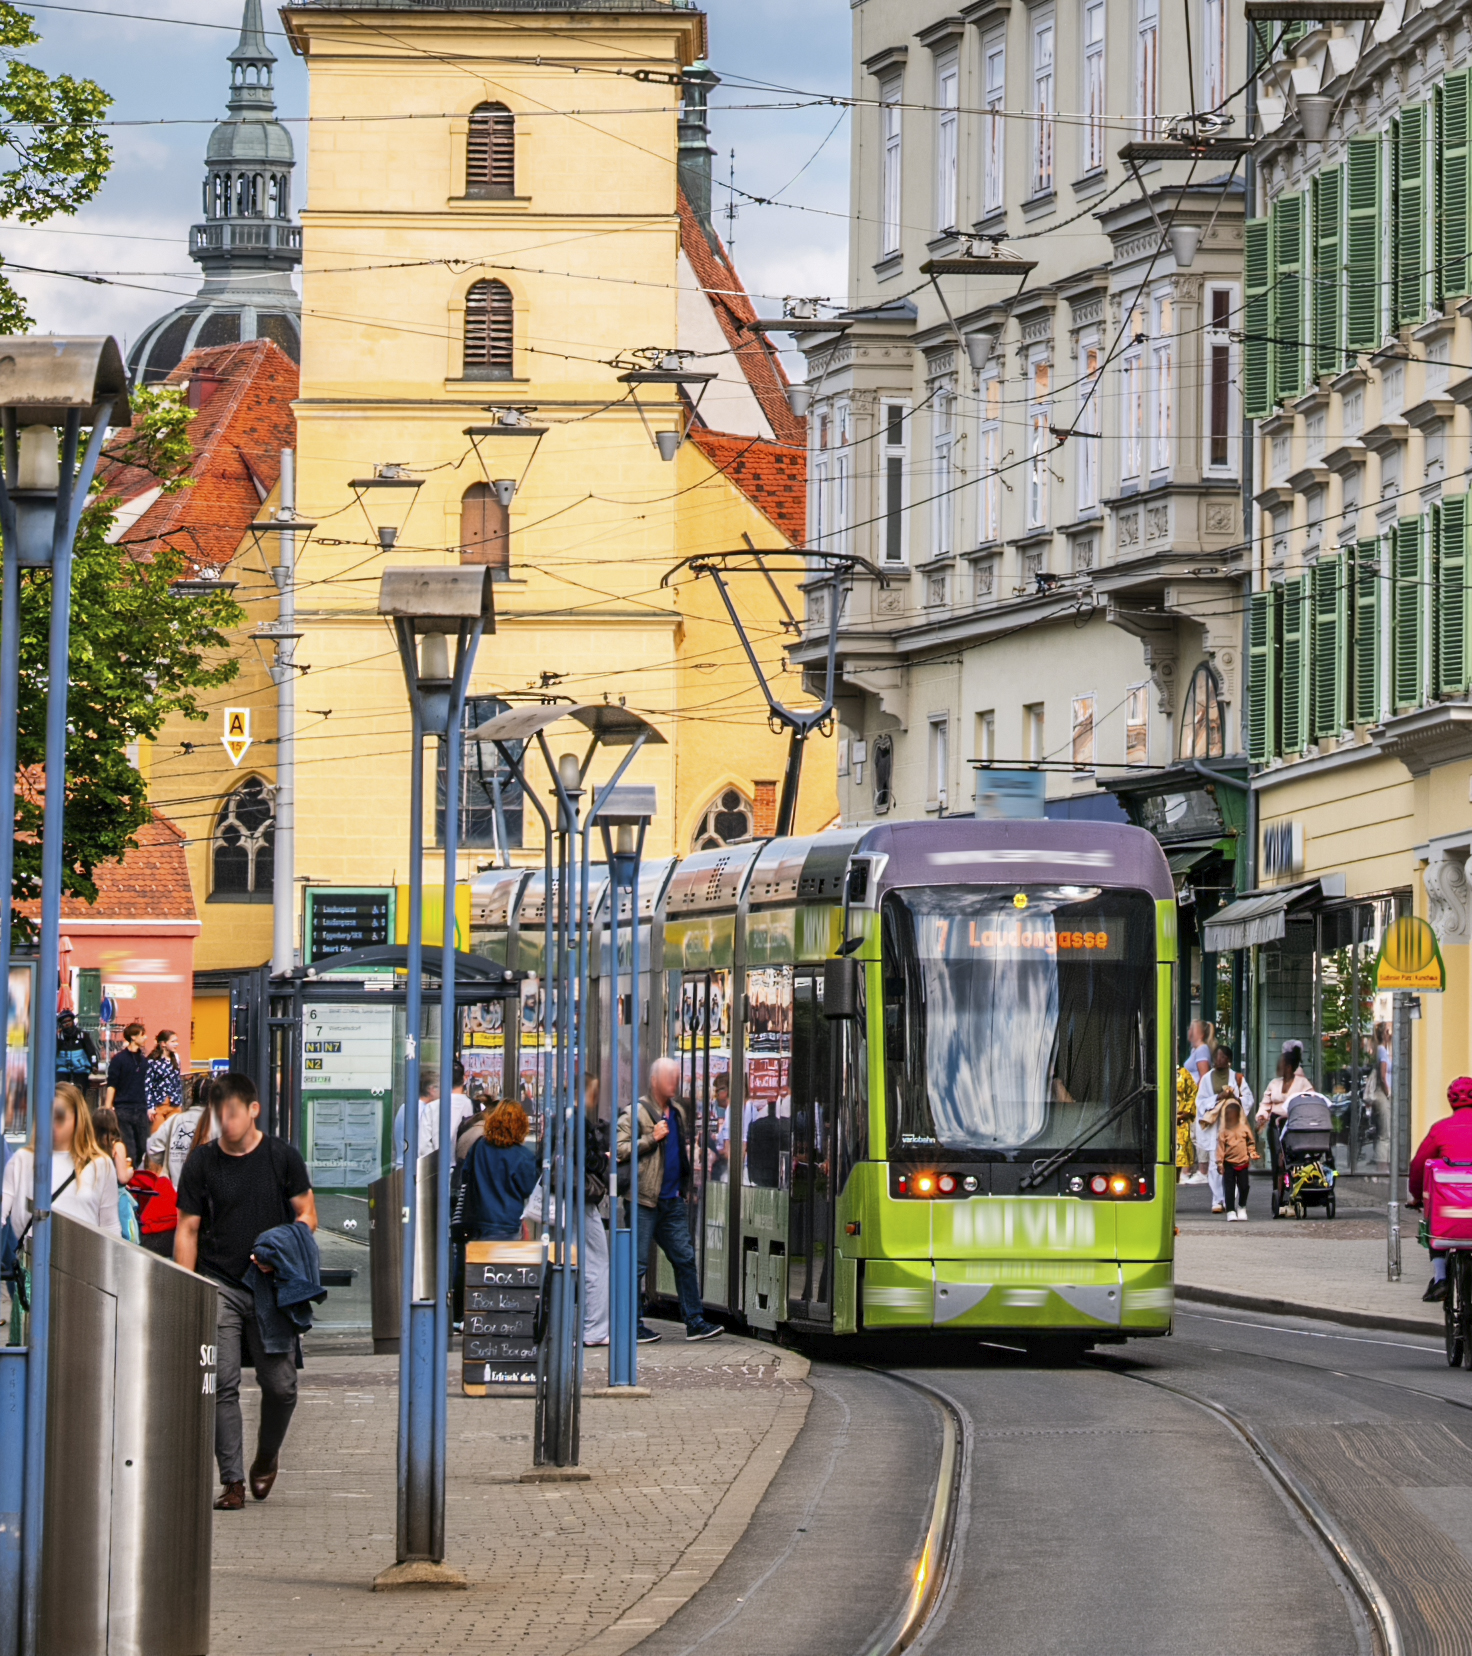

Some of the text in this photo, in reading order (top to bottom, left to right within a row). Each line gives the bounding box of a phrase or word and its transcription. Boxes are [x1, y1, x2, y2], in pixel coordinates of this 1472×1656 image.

[230, 714, 244, 734] A
[232, 742, 242, 750] 15
[936, 920, 1109, 954] 7 Laudongasse
[310, 1010, 317, 1020] 6
[316, 1026, 322, 1036] 7
[306, 1042, 340, 1052] N1 N7
[306, 1060, 322, 1068] N2
[483, 1266, 514, 1284] Box
[472, 1292, 494, 1308] Box
[471, 1316, 522, 1334] Box groß
[470, 1342, 498, 1357] Sushi
[502, 1344, 518, 1356] Box
